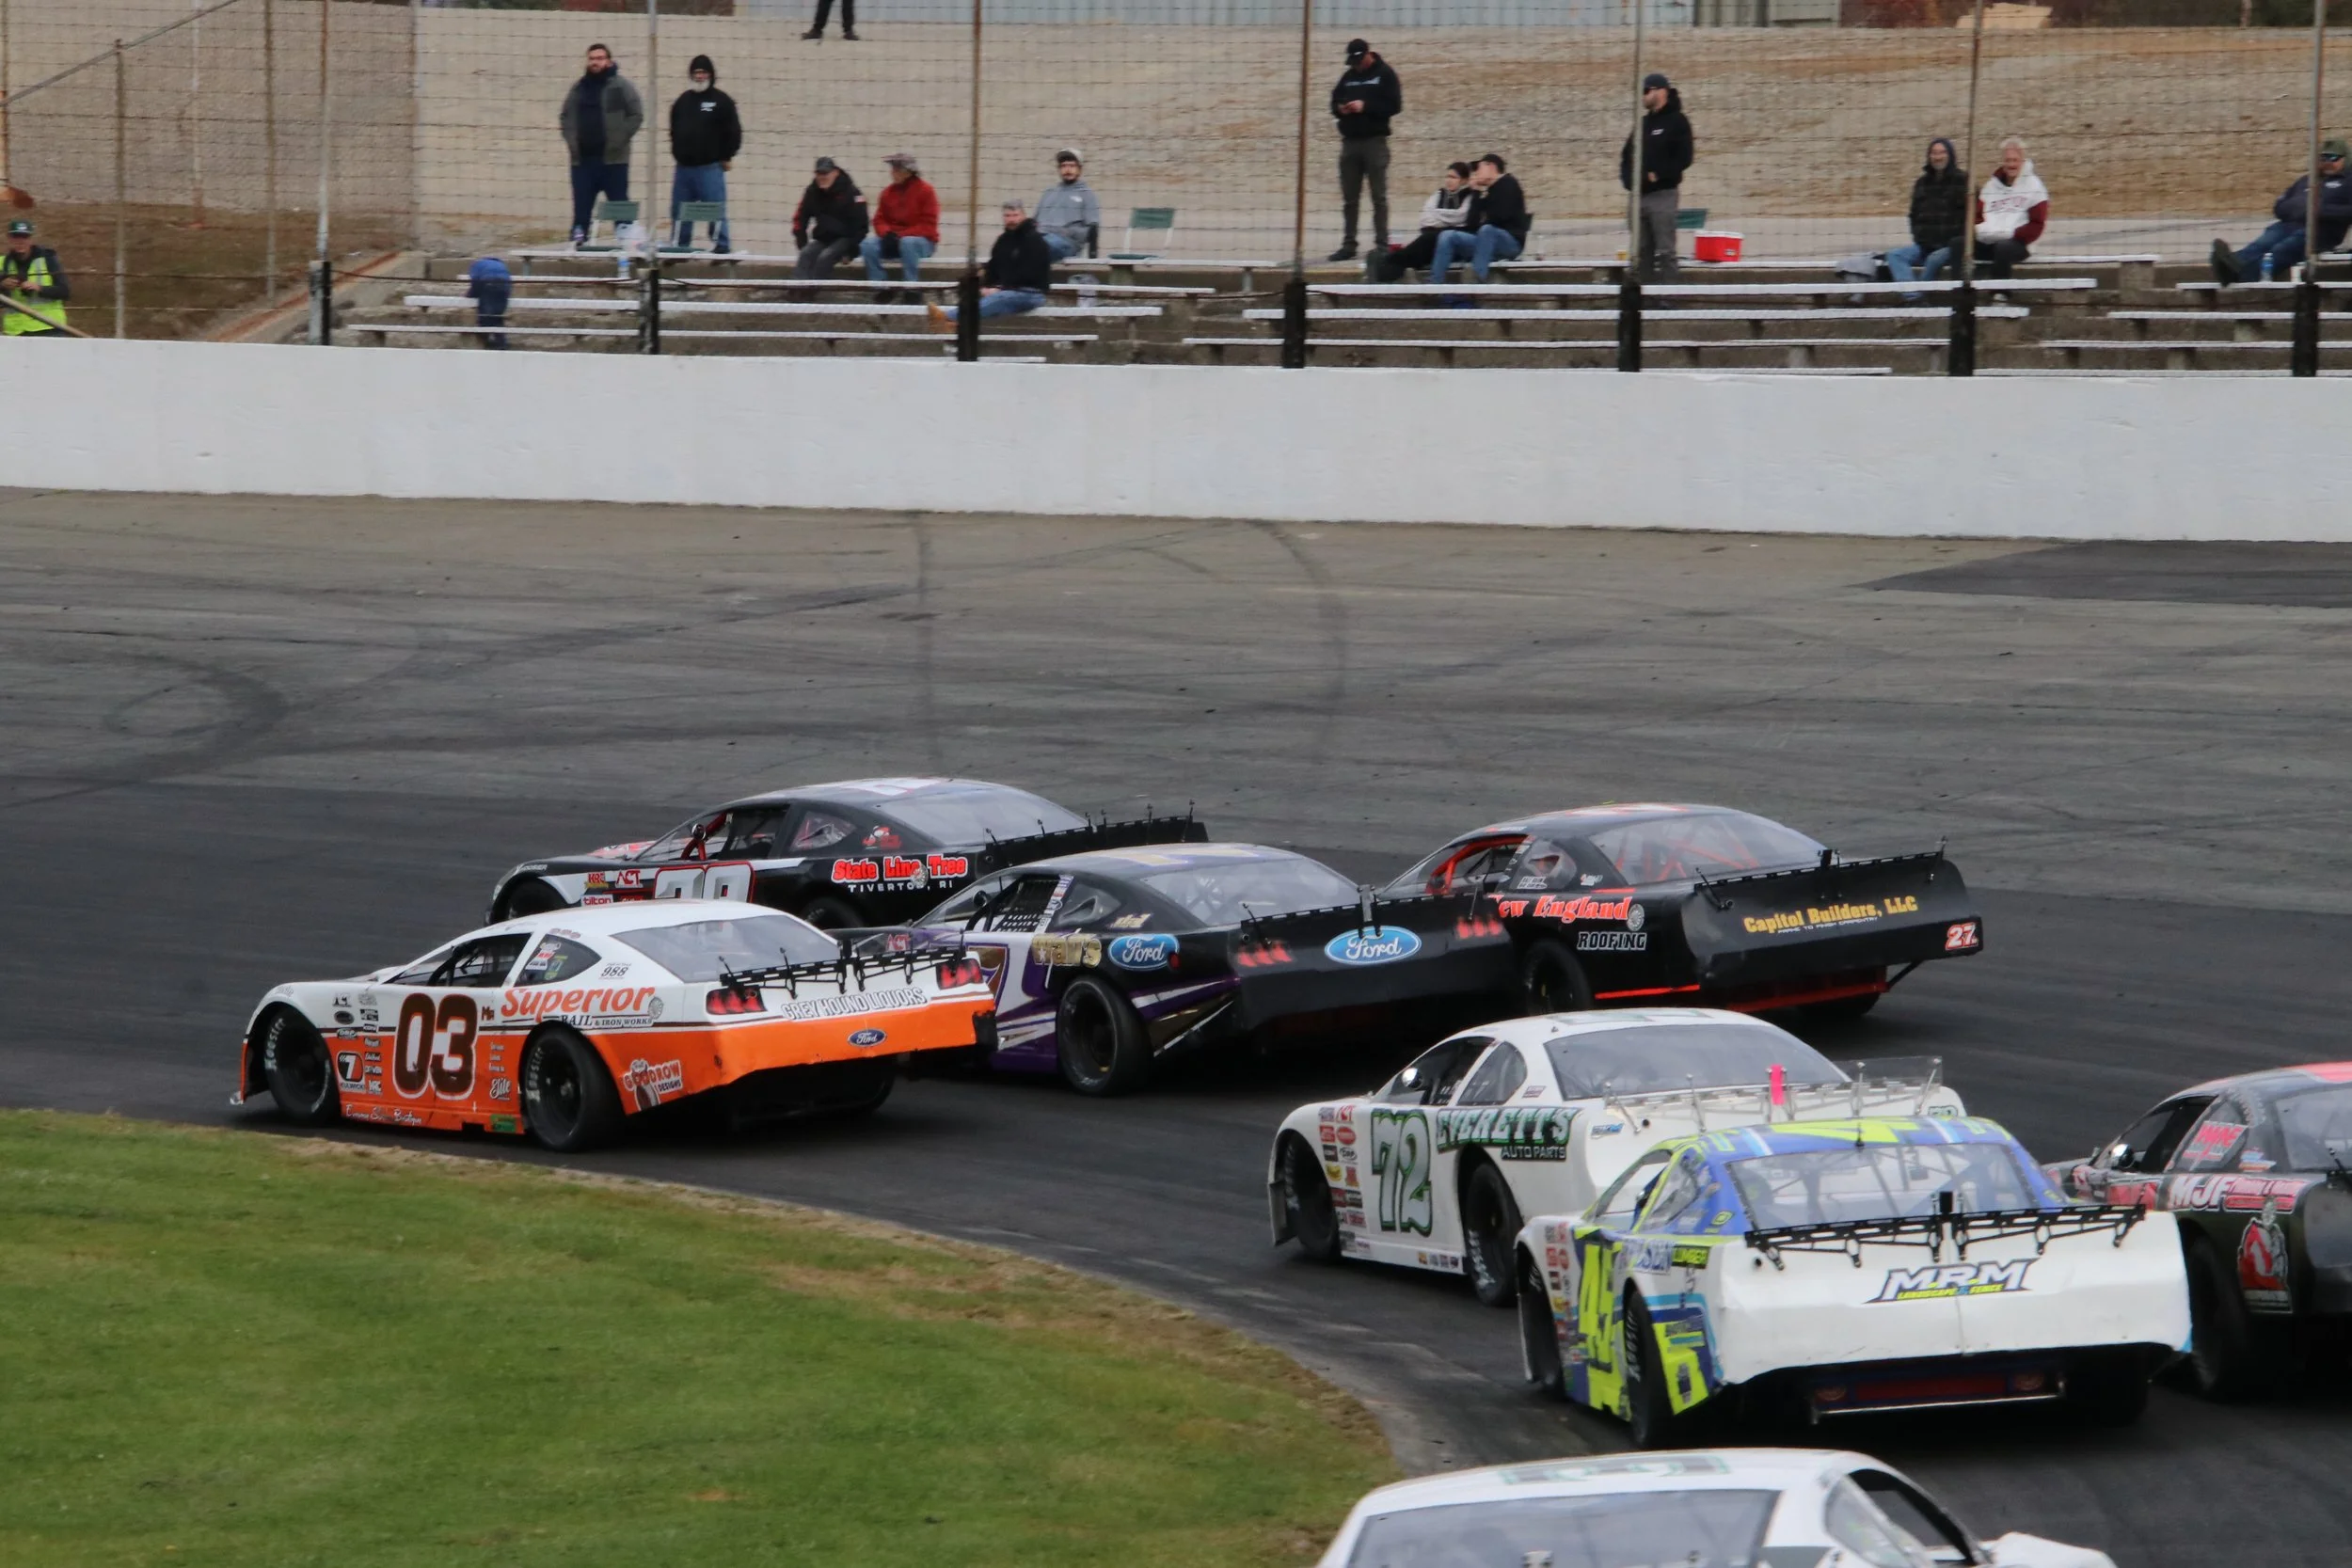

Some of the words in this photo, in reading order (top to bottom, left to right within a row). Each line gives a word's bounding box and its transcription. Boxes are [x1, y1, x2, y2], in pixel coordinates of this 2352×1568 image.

[616, 869, 641, 885] ACT
[833, 858, 879, 882] State
[927, 853, 968, 879] Tree
[848, 880, 930, 893] TIVERTO,
[940, 880, 953, 889] RI
[583, 896, 612, 905] tilton
[1488, 895, 1530, 918] ew
[1533, 895, 1632, 924] England
[1743, 910, 1804, 934] Capitol
[1807, 902, 1883, 925] Builders,
[1884, 895, 1918, 914] LLC
[1345, 933, 1403, 960] Ford
[1577, 932, 1646, 951] ROOFING
[1945, 922, 1979, 951] 27
[601, 966, 628, 977] 988
[501, 987, 656, 1023] Superior
[866, 987, 928, 1009] LIQUORS
[561, 1015, 593, 1026] RAIL
[395, 993, 477, 1099] 03
[658, 1079, 681, 1092] DESIGNS
[1502, 1147, 1533, 1160] AUTO
[1534, 1146, 1566, 1160] PARTS
[1371, 1108, 1433, 1237] 72
